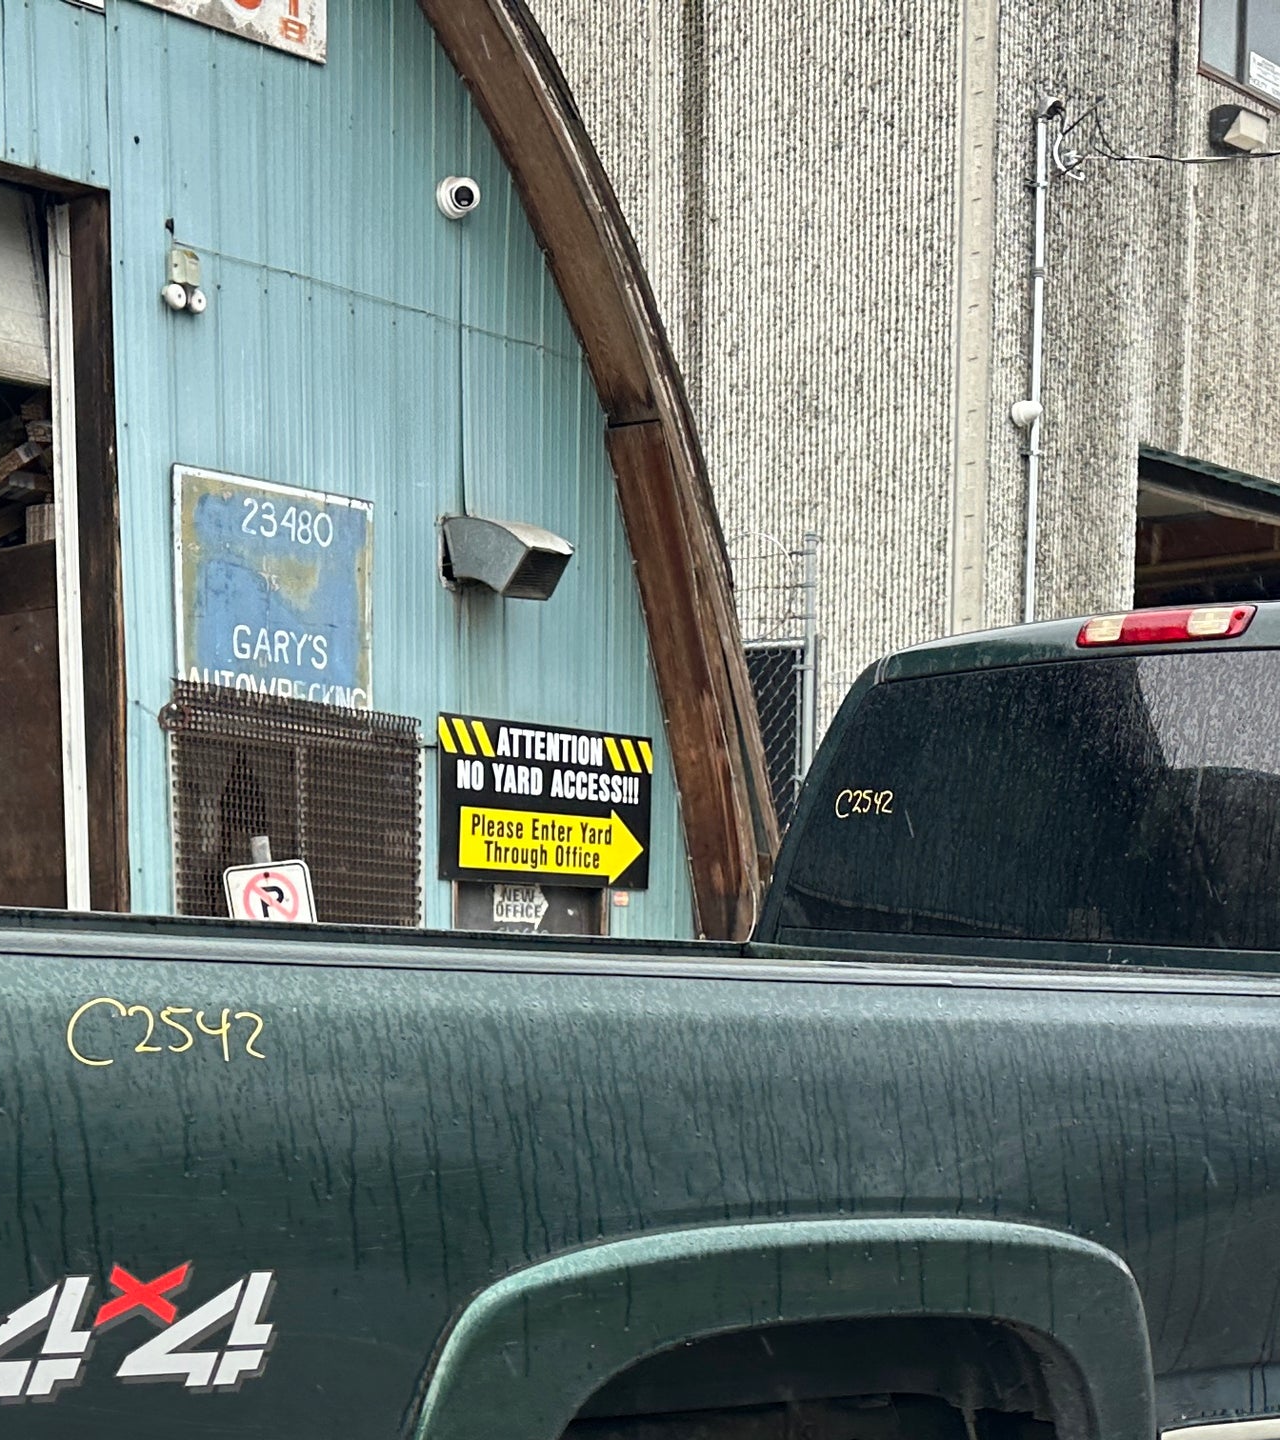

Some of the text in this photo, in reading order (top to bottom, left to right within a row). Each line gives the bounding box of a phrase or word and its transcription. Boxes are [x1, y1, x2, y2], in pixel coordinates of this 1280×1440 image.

[241, 497, 334, 548] 23480
[232, 624, 329, 670] GARY'S
[496, 726, 603, 767] ATTENTION
[456, 759, 639, 804] NO YARD ACCESS!!!
[835, 788, 894, 818] C2542
[471, 813, 612, 845] Please Enter Yard
[484, 840, 600, 869] Through Office
[495, 903, 543, 919] OFFICE
[501, 885, 535, 902] NEW
[66, 997, 266, 1066] C2542
